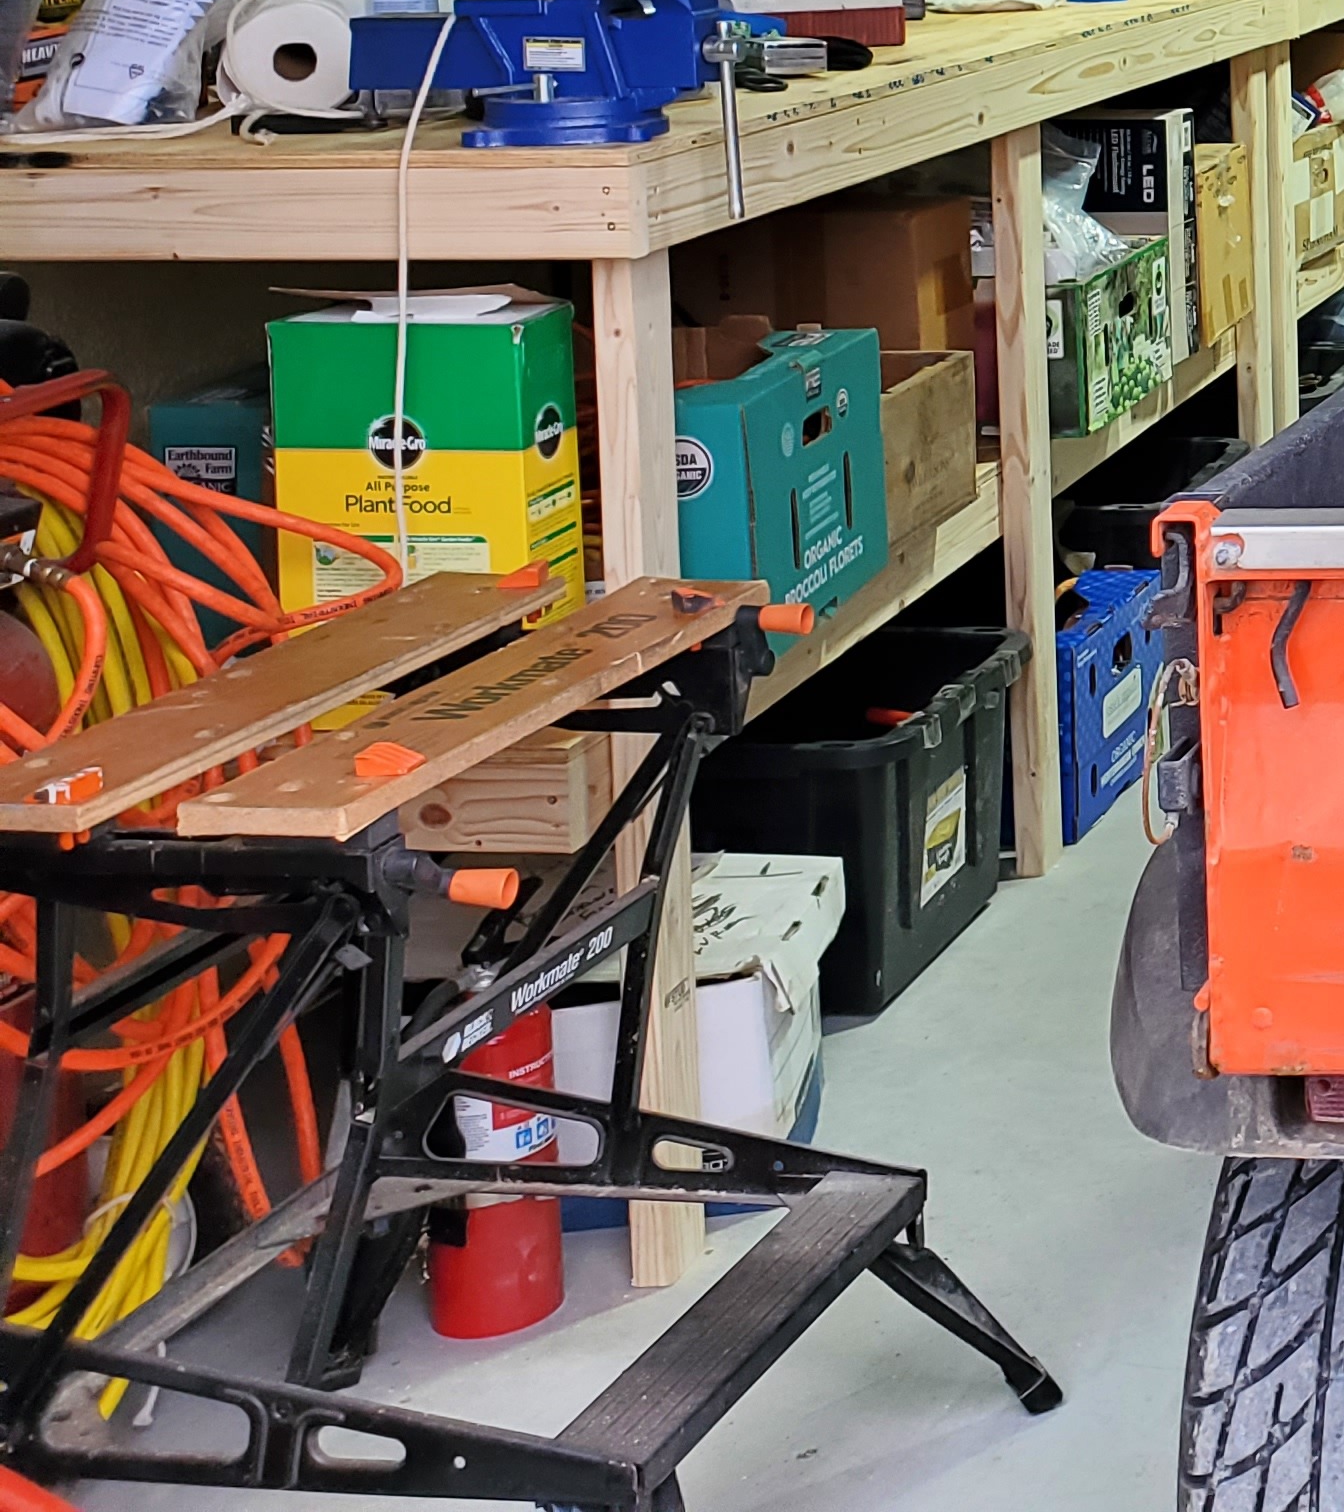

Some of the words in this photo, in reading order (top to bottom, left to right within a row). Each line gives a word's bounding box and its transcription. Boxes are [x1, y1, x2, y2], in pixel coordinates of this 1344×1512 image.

[1142, 164, 1155, 204] LED
[168, 449, 232, 461] Earthbound
[205, 462, 232, 474] Farm
[675, 453, 697, 466] SDA
[366, 481, 381, 492] All
[385, 482, 430, 494] Pupose
[345, 494, 396, 513] Plant
[803, 523, 843, 569] ORGANIC
[828, 534, 864, 578] FLORETS
[410, 647, 593, 721] Workmate
[576, 611, 658, 639] 200
[586, 925, 614, 961] 200
